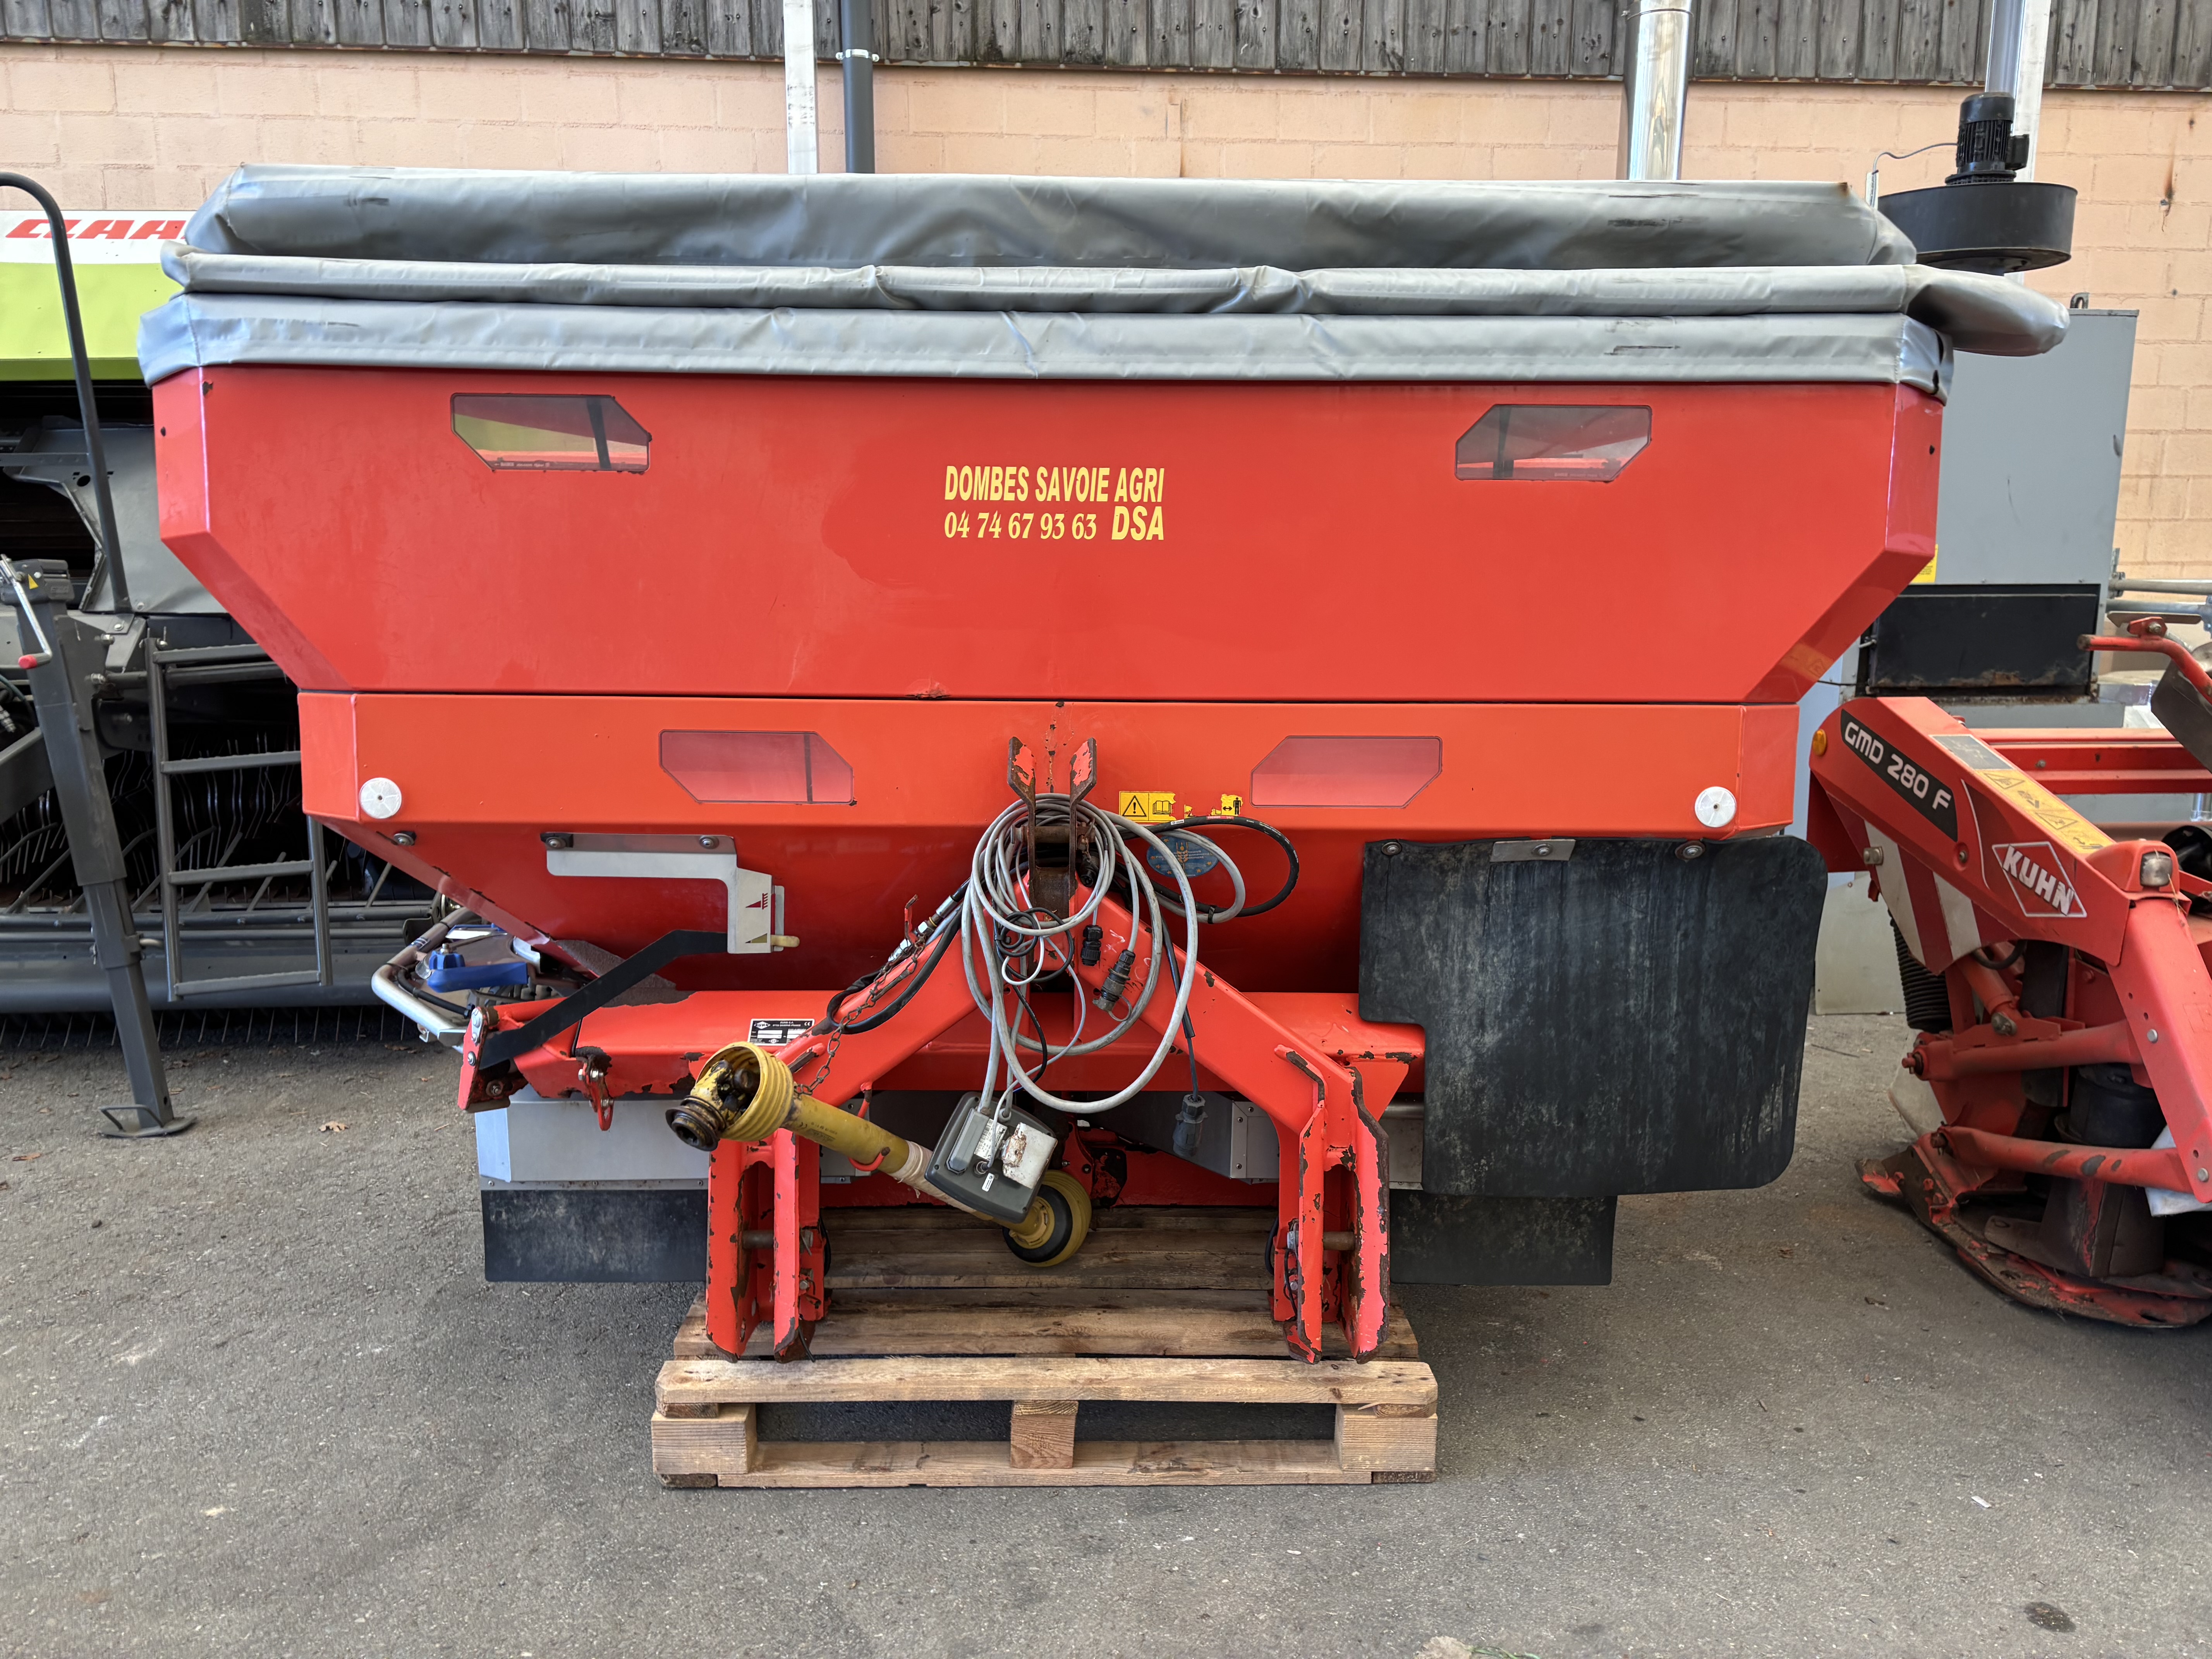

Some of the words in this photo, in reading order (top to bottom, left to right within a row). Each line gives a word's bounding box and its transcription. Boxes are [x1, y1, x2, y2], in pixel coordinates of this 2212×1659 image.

[945, 465, 1029, 501] DOMBES
[1035, 466, 1110, 502] SAVOIE
[1114, 467, 1165, 503] AGRI
[944, 510, 970, 539] 04
[977, 510, 1002, 539] 74
[1008, 512, 1034, 539] 67
[1040, 512, 1065, 540] 93
[1071, 513, 1097, 540] 63
[1111, 505, 1164, 541] DSA
[1844, 721, 1884, 764] GMD
[1887, 753, 1929, 799] 280
[1932, 788, 1952, 810] F
[2002, 845, 2074, 915] KUHN
